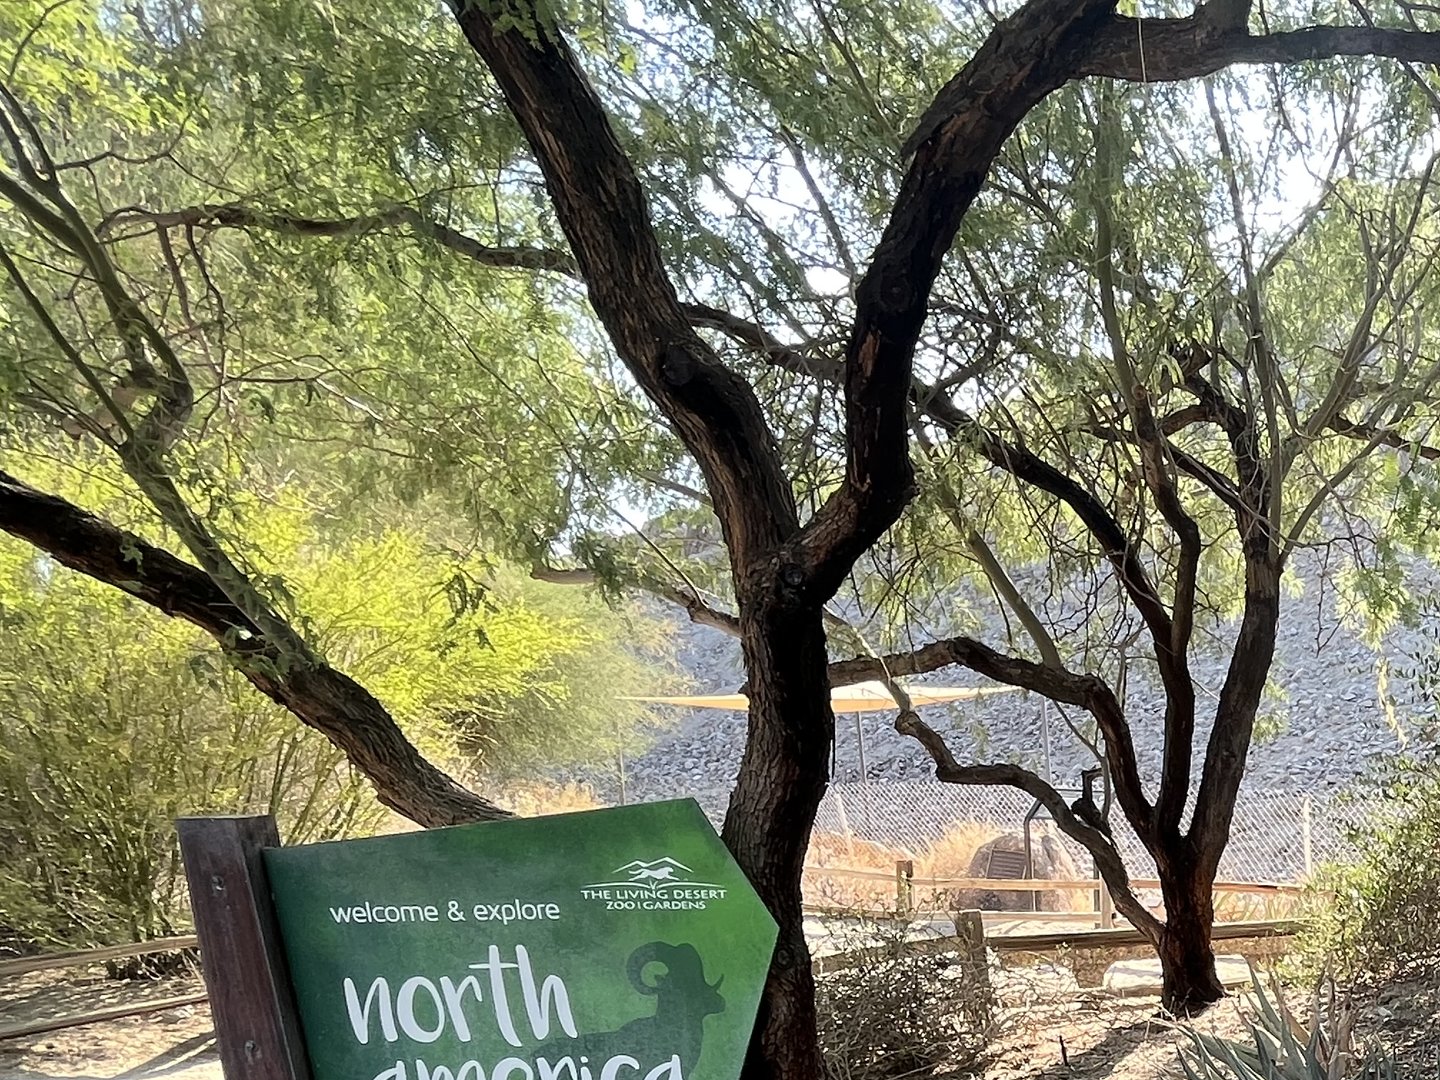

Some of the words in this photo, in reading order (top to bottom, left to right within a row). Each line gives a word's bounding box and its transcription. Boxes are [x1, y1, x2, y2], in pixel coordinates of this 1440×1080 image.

[580, 889, 611, 899] THE
[616, 889, 669, 899] LIVING
[673, 889, 728, 899] DESERT
[330, 902, 439, 925] welcome
[447, 902, 467, 922] &
[472, 899, 560, 925] explore
[606, 901, 635, 910] ZOO
[643, 901, 706, 910] GARDENS
[343, 944, 579, 1047] north
